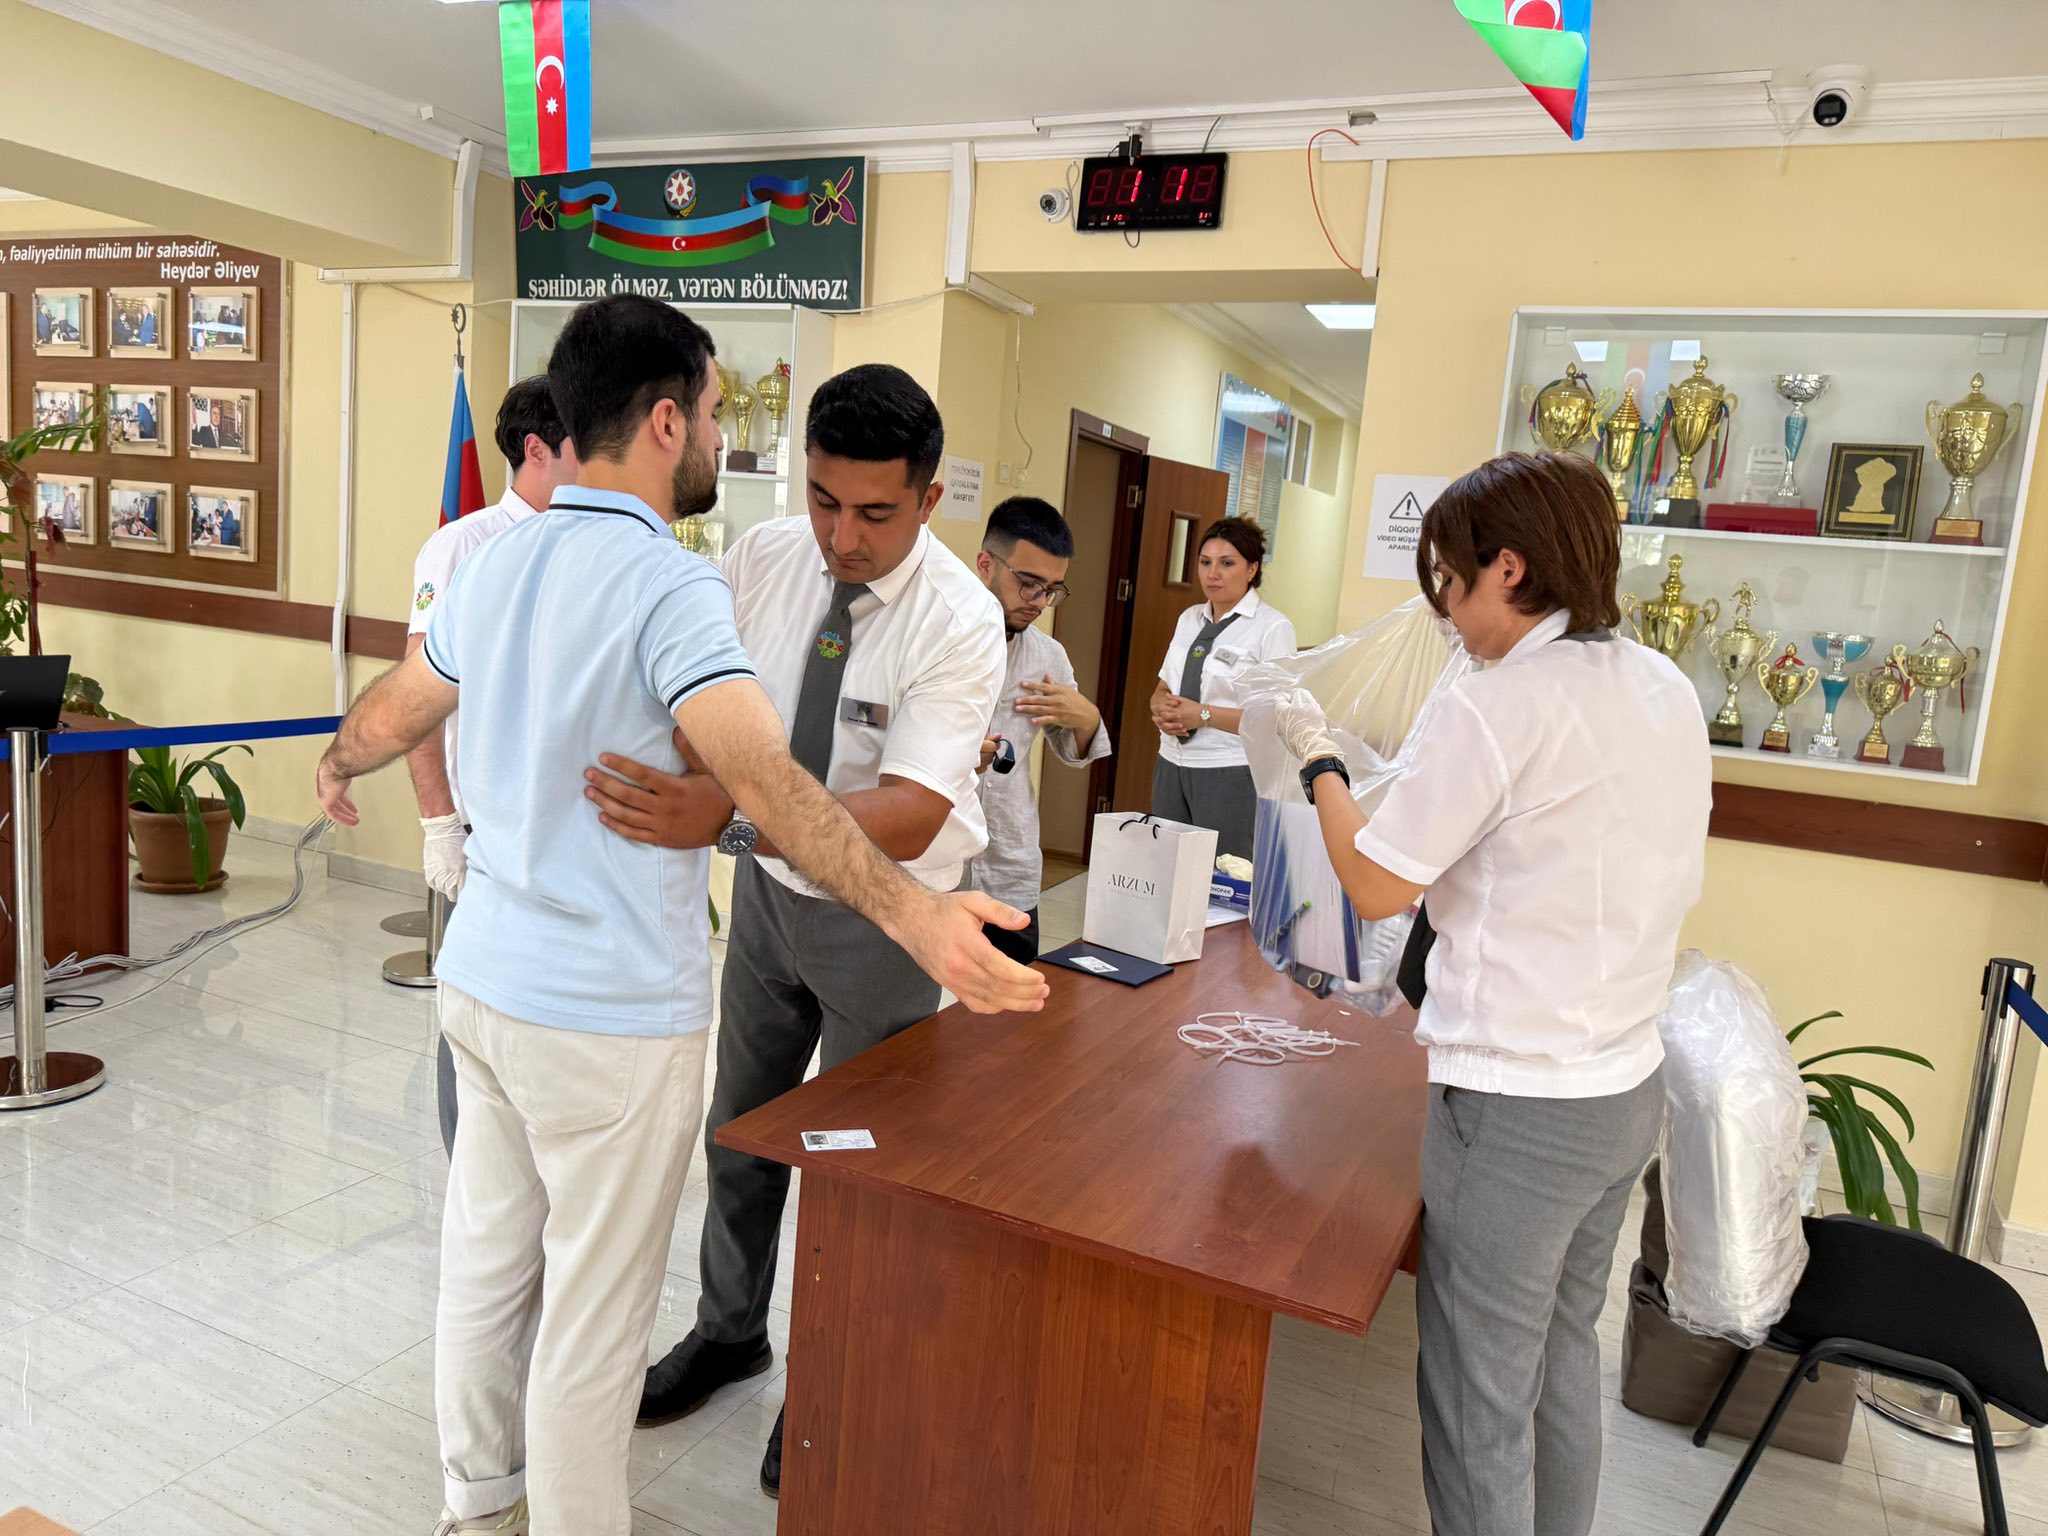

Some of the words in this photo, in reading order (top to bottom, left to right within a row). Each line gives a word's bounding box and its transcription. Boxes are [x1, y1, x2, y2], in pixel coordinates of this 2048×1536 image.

[10, 244, 82, 264] fəaliyyətinin
[85, 243, 132, 259] mühüm
[135, 242, 154, 258] bir
[156, 241, 220, 258] sahəsidir.
[161, 261, 211, 283] Heydər
[214, 261, 260, 283] Əliyev
[528, 273, 607, 300] ŞƏHİDLƏR
[678, 278, 735, 298] VƏTƏN
[740, 272, 848, 301] BÖLÜNMƏZ!
[1108, 873, 1155, 896] ARZUM
